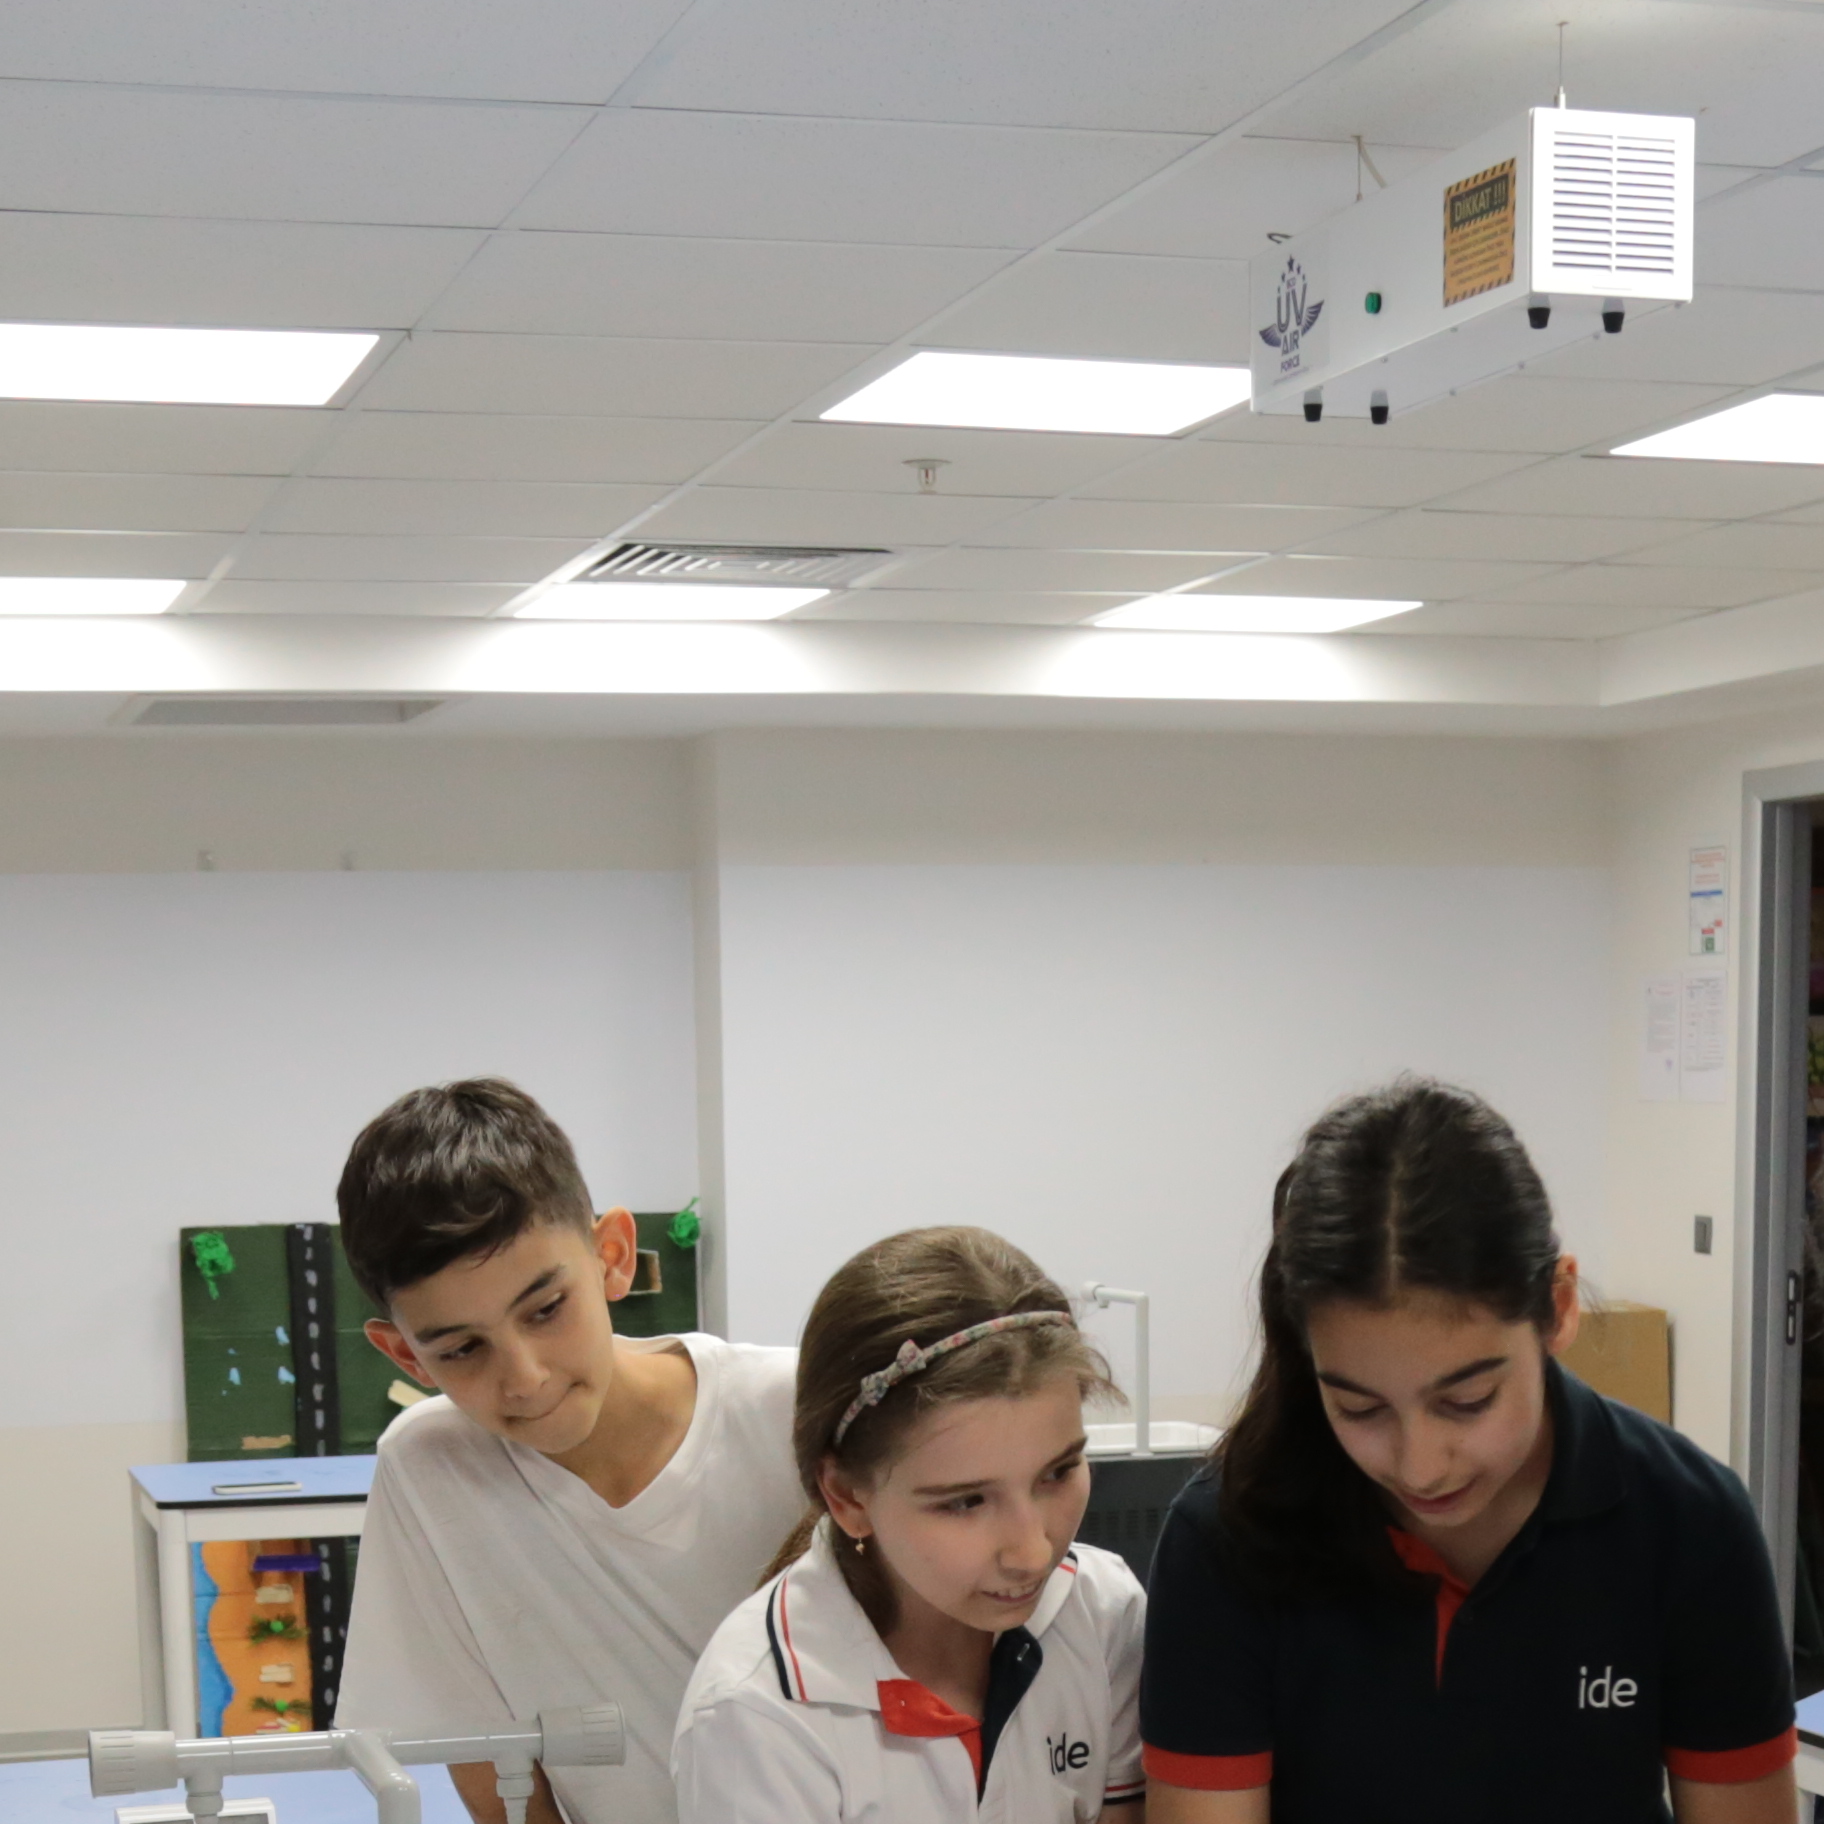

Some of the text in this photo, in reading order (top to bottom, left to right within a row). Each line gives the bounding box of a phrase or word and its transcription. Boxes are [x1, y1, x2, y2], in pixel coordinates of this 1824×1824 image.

[1454, 187, 1492, 222] DİKKAT
[1281, 329, 1300, 356] AIR
[1578, 1665, 1638, 1709] ide
[1046, 1732, 1090, 1775] ide
